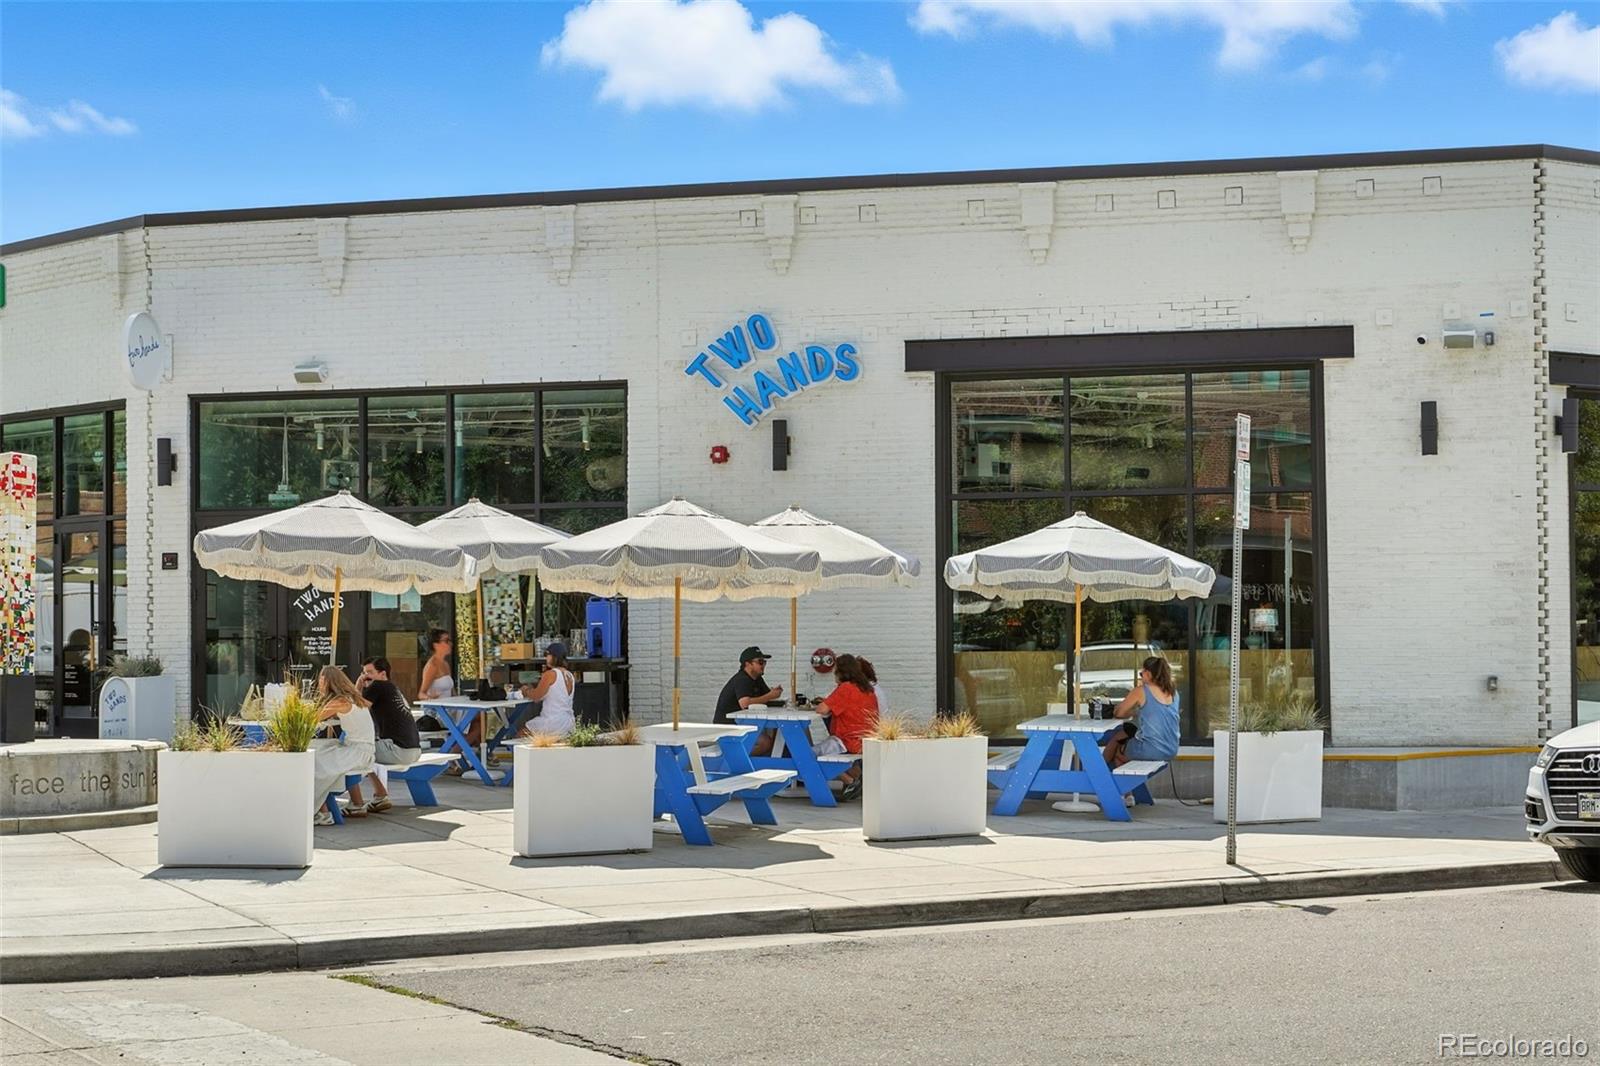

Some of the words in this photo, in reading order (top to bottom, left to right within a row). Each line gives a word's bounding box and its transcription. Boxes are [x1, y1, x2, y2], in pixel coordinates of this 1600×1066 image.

[685, 313, 776, 389] TWO
[722, 343, 860, 426] HANDS
[293, 586, 320, 610] TWO
[304, 596, 345, 622] HANDS
[10, 773, 65, 796] face
[79, 769, 111, 793] the
[121, 771, 146, 790] sun
